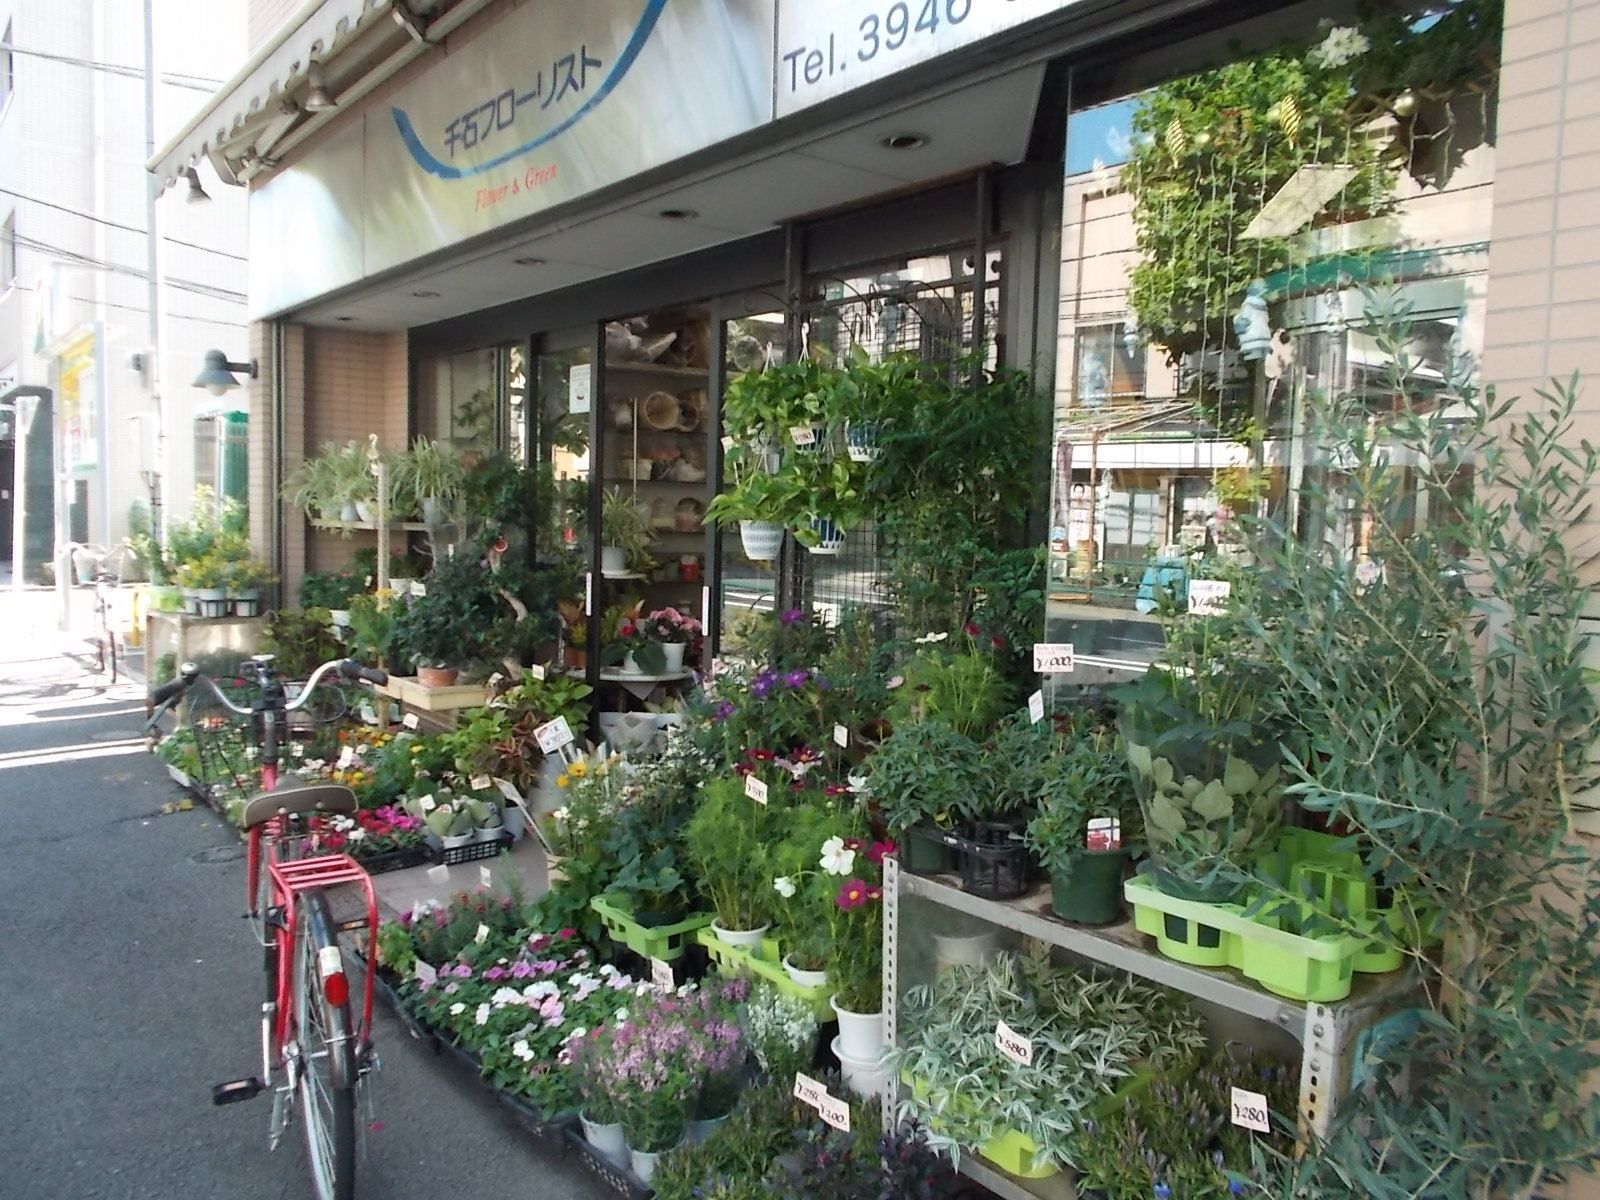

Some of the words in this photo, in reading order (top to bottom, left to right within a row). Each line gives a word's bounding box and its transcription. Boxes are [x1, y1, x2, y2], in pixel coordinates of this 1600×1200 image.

[783, 33, 846, 91] Tel.
[444, 44, 602, 156] 千石フローリスト
[475, 184, 508, 212] Flower
[512, 176, 520, 195] &
[525, 163, 557, 190] Green
